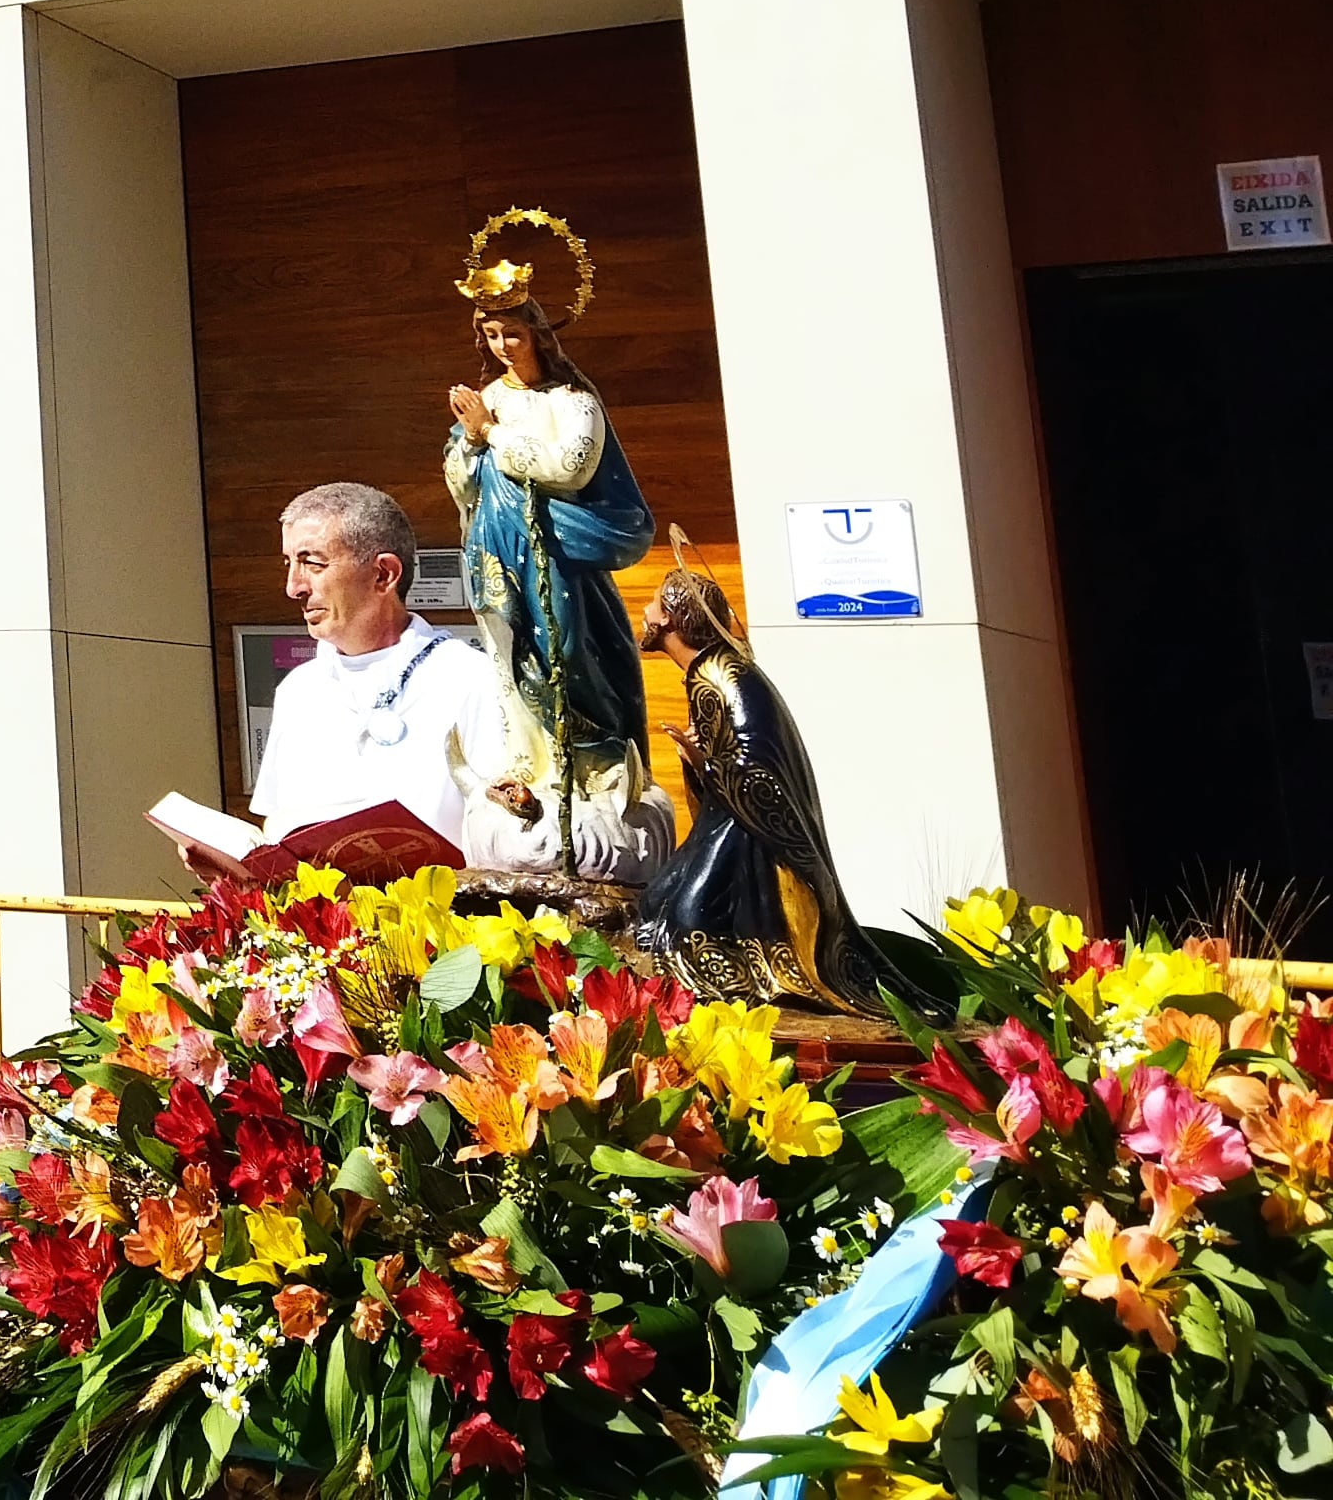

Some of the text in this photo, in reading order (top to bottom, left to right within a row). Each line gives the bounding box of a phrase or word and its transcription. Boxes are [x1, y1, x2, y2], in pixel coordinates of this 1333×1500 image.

[1231, 169, 1311, 191] EIXIDA
[1233, 193, 1314, 214] SALIDA
[1238, 217, 1313, 237] EXIT
[837, 602, 864, 613] 2024
